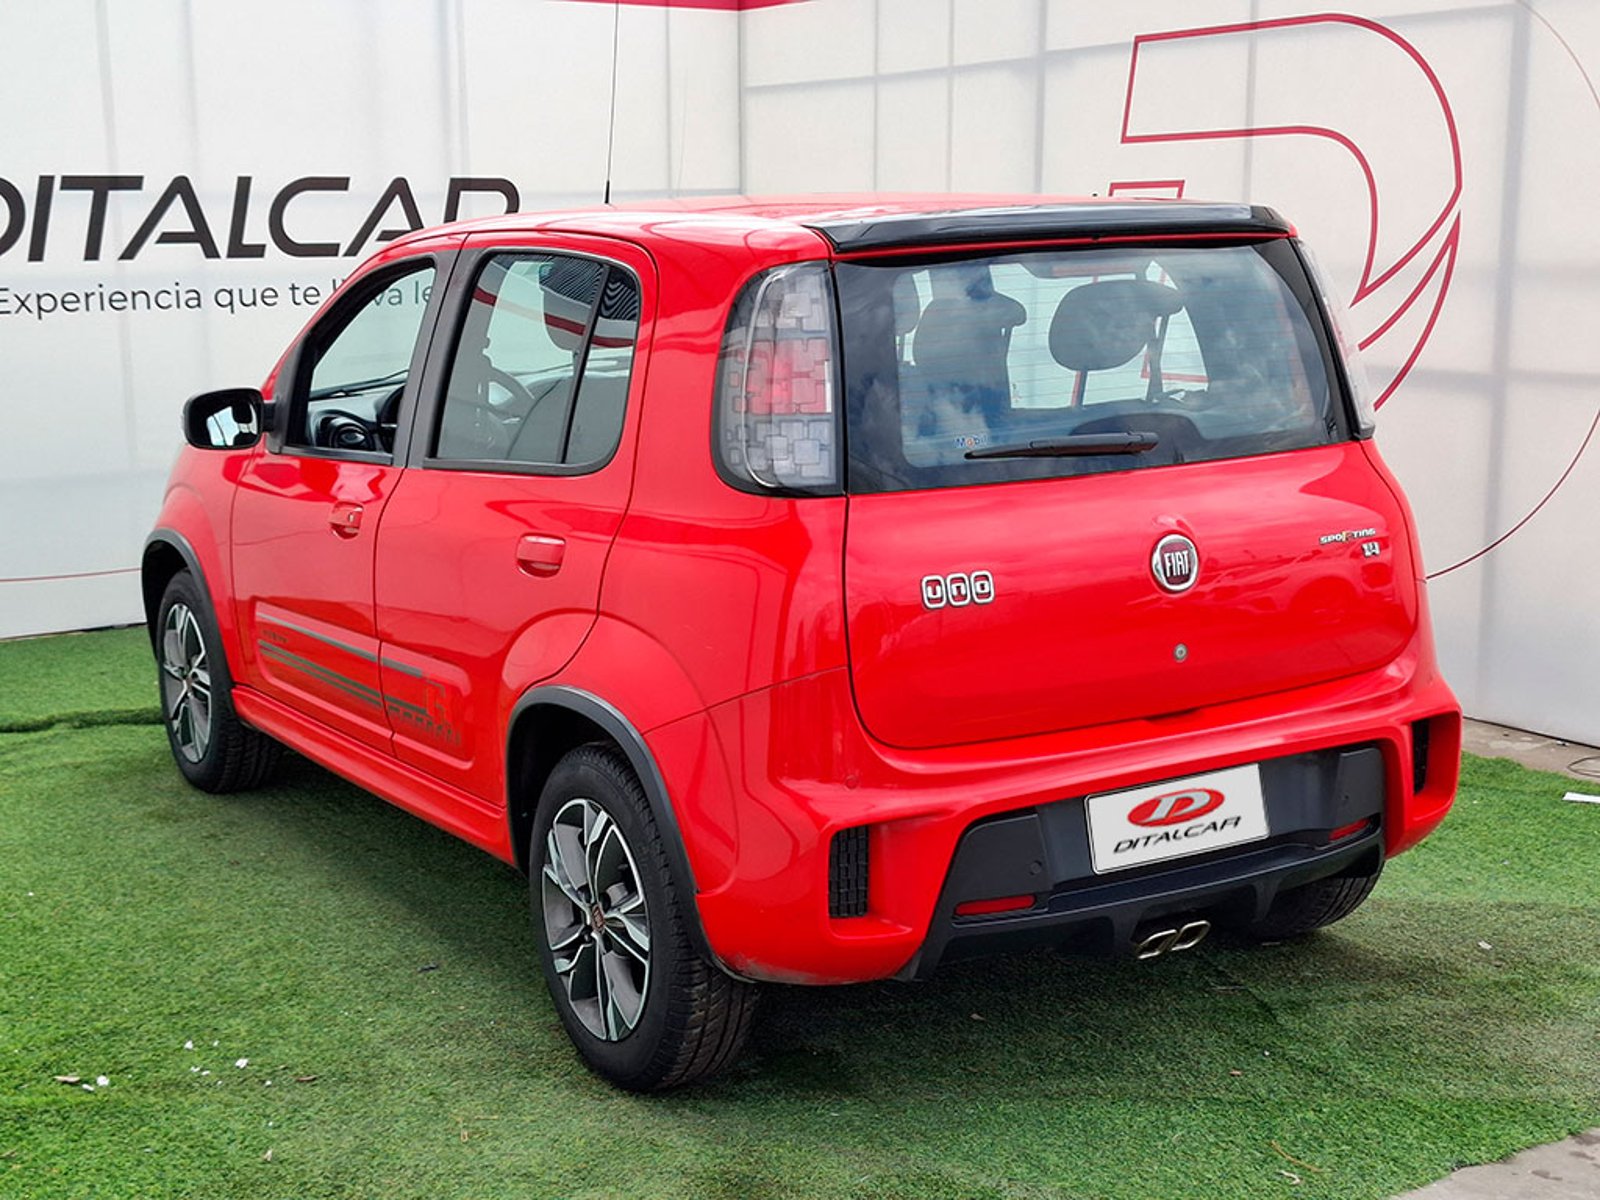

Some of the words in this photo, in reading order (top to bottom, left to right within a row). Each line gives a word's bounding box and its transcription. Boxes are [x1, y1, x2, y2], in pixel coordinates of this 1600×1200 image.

[0, 282, 202, 320] Experiencia
[214, 285, 279, 315] que
[289, 282, 321, 306] te
[1163, 550, 1189, 578] FIAT
[1112, 815, 1242, 854] DITALCAR
